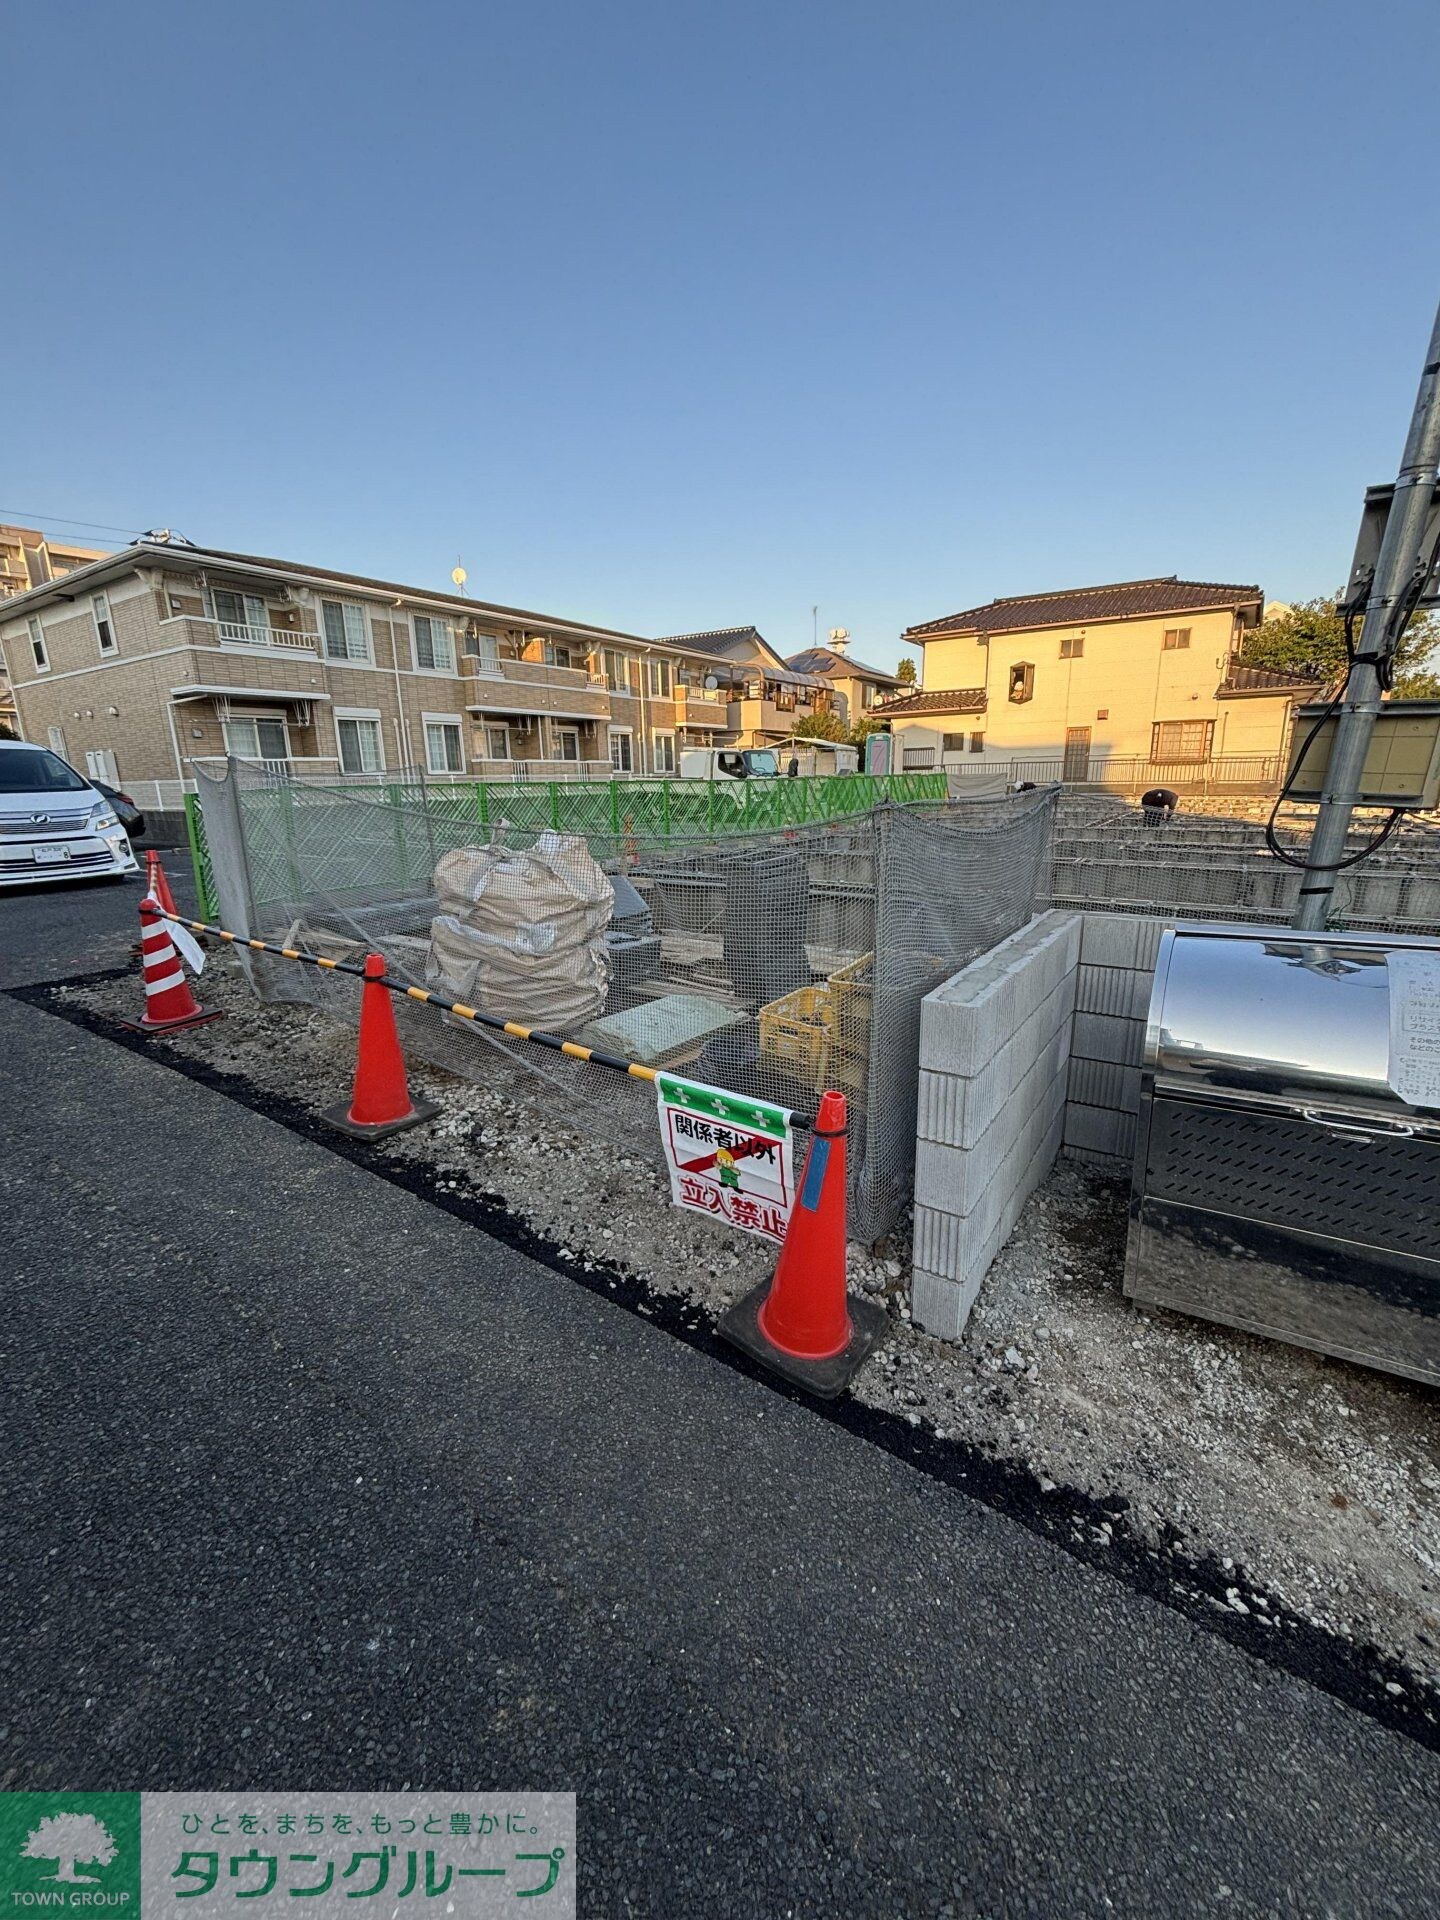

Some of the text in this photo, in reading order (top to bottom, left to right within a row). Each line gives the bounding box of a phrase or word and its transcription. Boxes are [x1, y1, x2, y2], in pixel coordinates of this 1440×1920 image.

[675, 1114, 777, 1165] 関係者以外
[679, 1175, 788, 1241] 立入禁止
